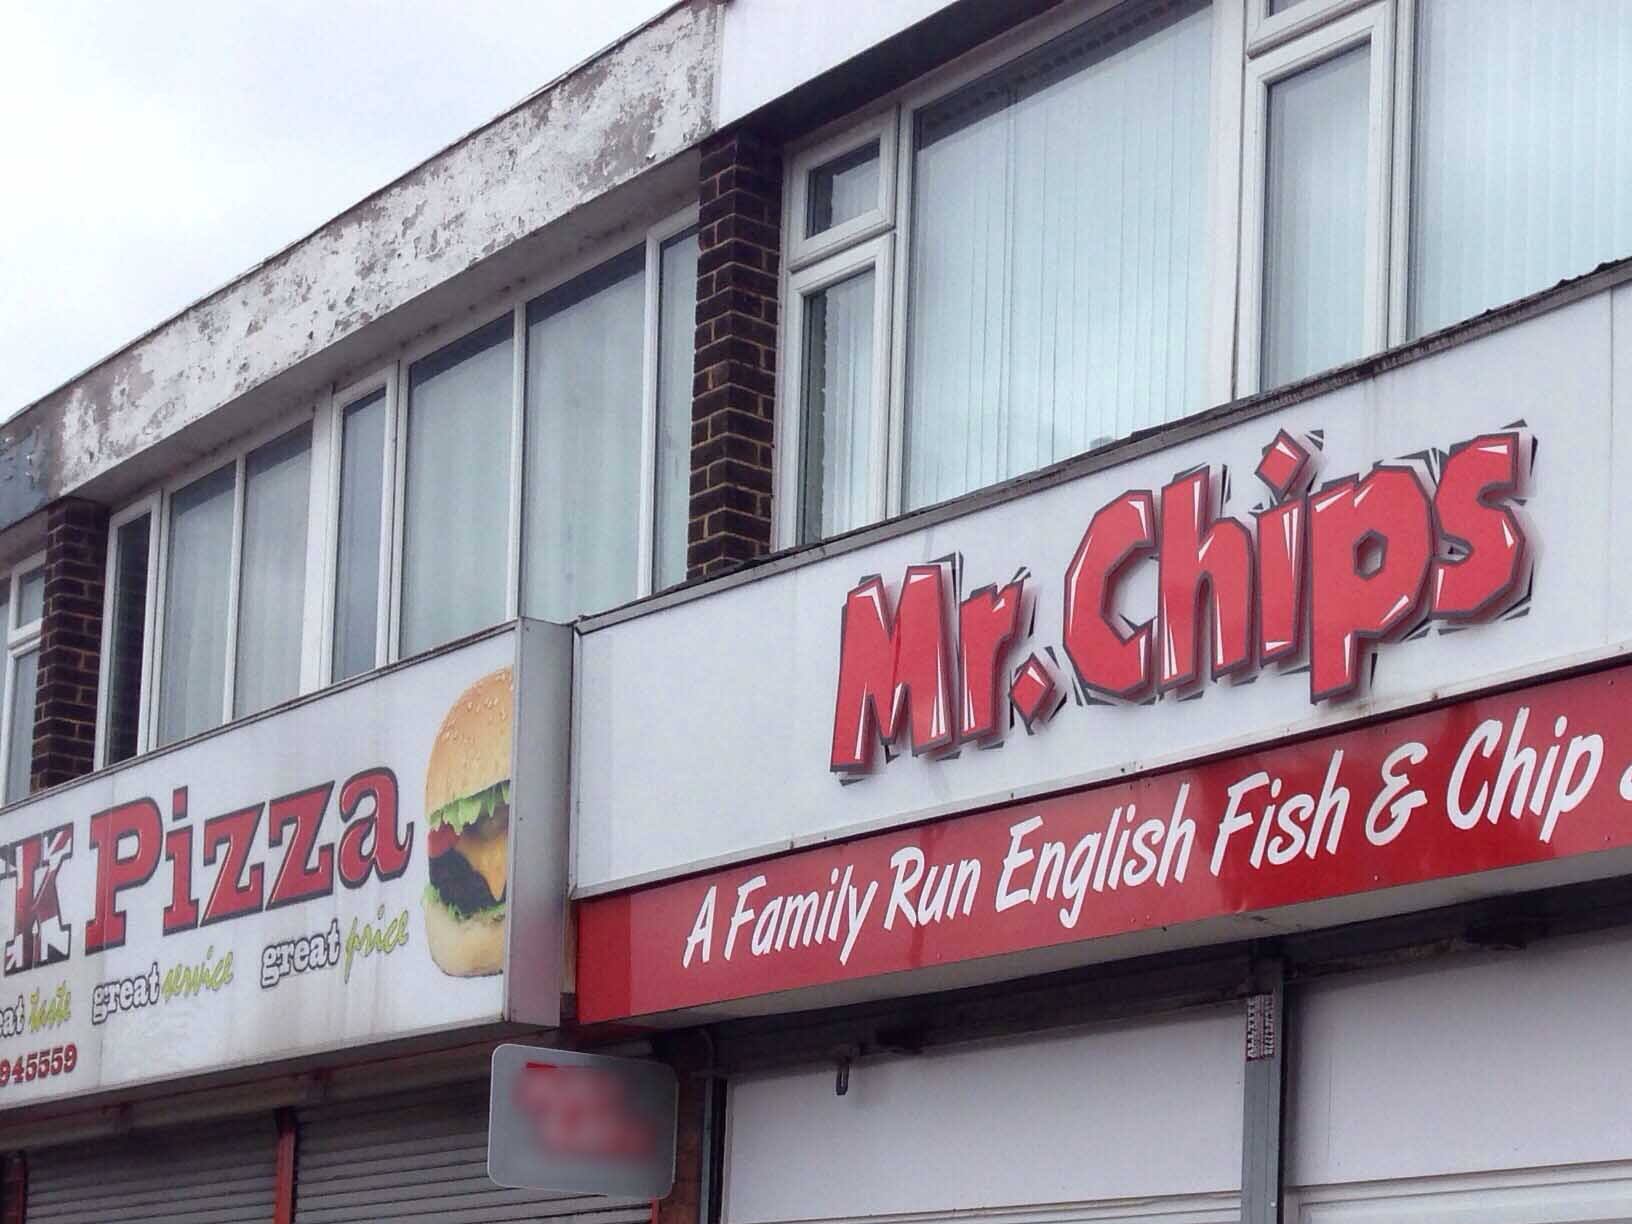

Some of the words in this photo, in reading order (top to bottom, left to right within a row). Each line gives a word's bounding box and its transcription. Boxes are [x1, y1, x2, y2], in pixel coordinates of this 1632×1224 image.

[85, 766, 413, 956] Pizza
[683, 885, 718, 968] A
[724, 865, 878, 965] Family
[884, 847, 982, 931] Run
[996, 783, 1196, 929] English
[1210, 750, 1350, 877] Fish
[1365, 742, 1428, 846] &
[1447, 707, 1604, 842] Chip
[0, 995, 25, 1037] at
[92, 962, 159, 1025] great
[162, 945, 233, 1003] service
[261, 918, 340, 988] great
[344, 904, 408, 984] price
